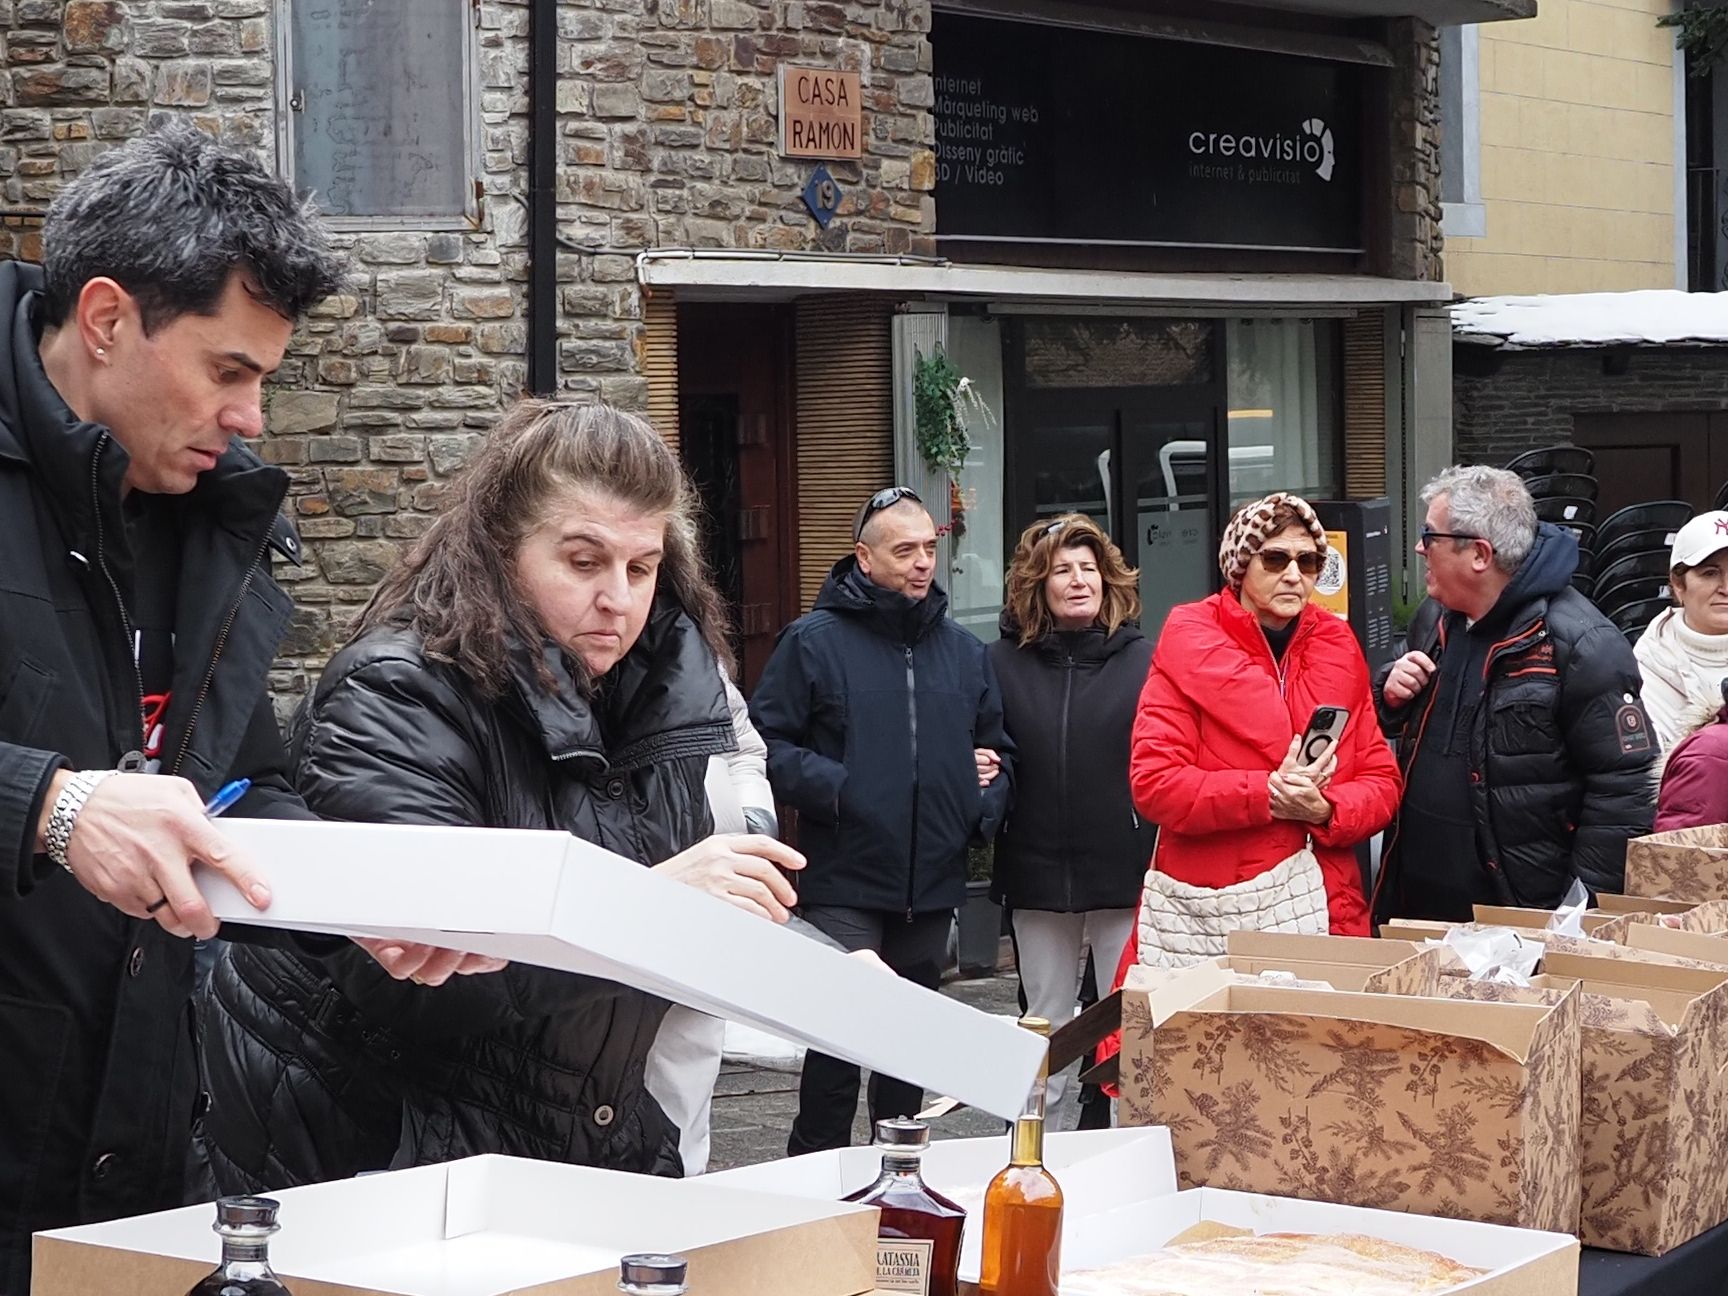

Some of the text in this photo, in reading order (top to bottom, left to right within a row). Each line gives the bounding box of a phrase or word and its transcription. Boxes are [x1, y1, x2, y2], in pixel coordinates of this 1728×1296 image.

[798, 76, 849, 107] CASA
[934, 76, 982, 95] nternet
[1011, 105, 1039, 122] web
[792, 119, 855, 150] RAMON
[1189, 131, 1320, 163] creavisio
[815, 180, 835, 209] 19
